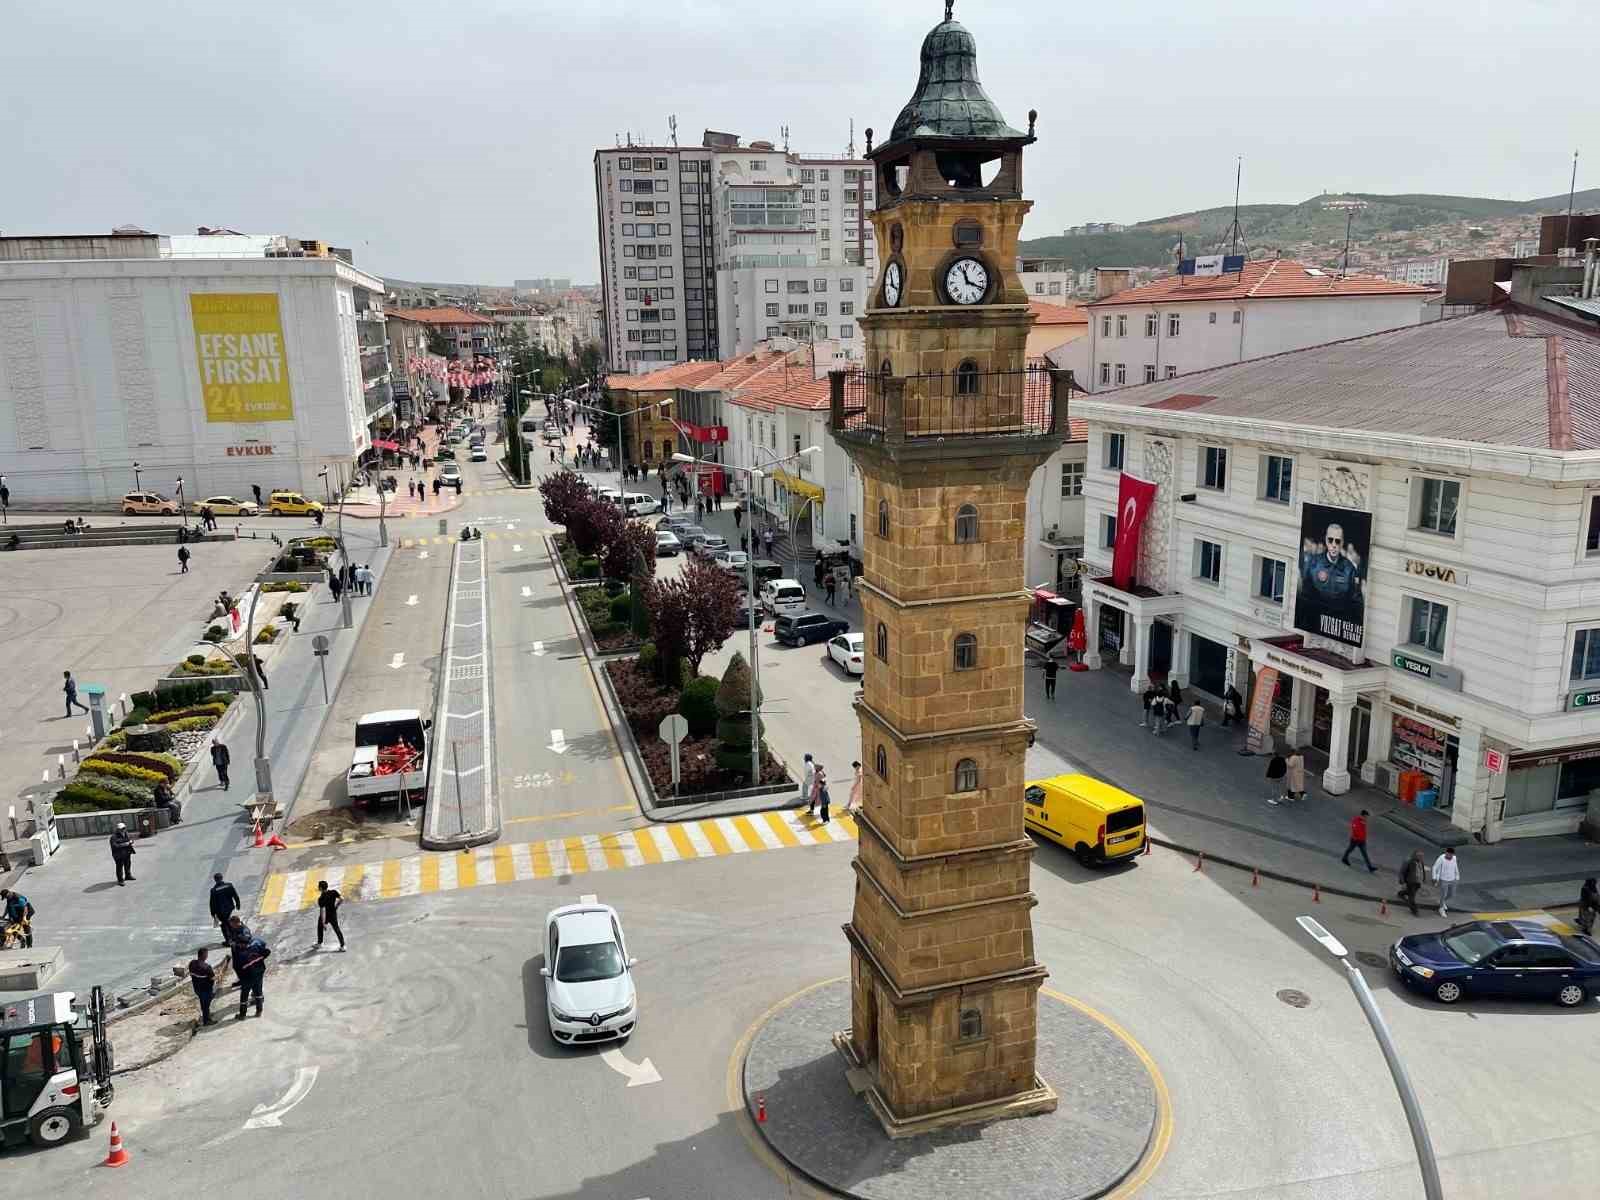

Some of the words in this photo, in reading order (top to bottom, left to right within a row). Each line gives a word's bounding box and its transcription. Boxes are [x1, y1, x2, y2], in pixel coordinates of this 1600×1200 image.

[200, 333, 281, 358] EFSANE
[204, 359, 282, 384] FIRSAT
[207, 387, 242, 413] 24
[226, 446, 273, 457] EVKUR
